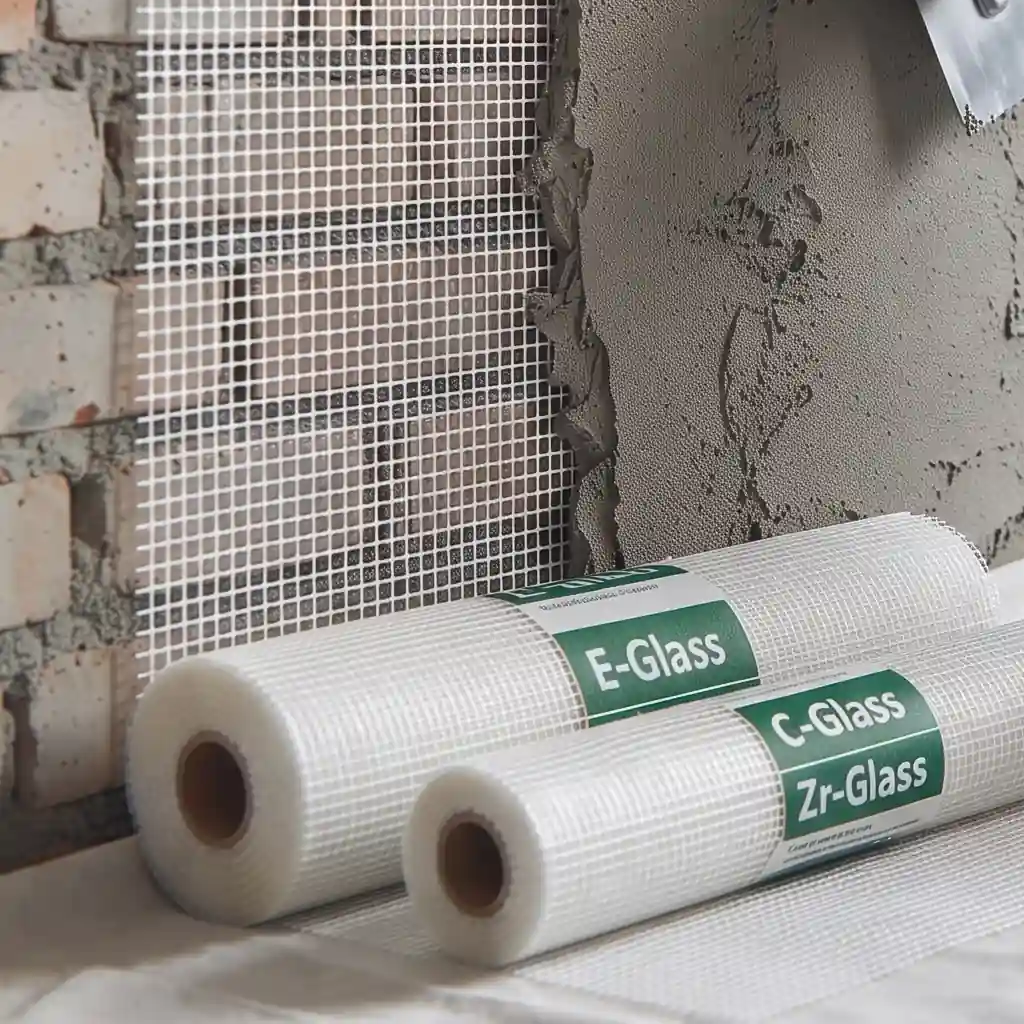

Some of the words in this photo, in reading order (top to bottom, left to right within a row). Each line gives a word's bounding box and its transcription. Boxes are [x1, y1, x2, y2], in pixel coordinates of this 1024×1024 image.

[585, 633, 727, 692] E-Glass
[771, 692, 906, 748] C-Glass
[797, 757, 928, 822] Zr-Glass
